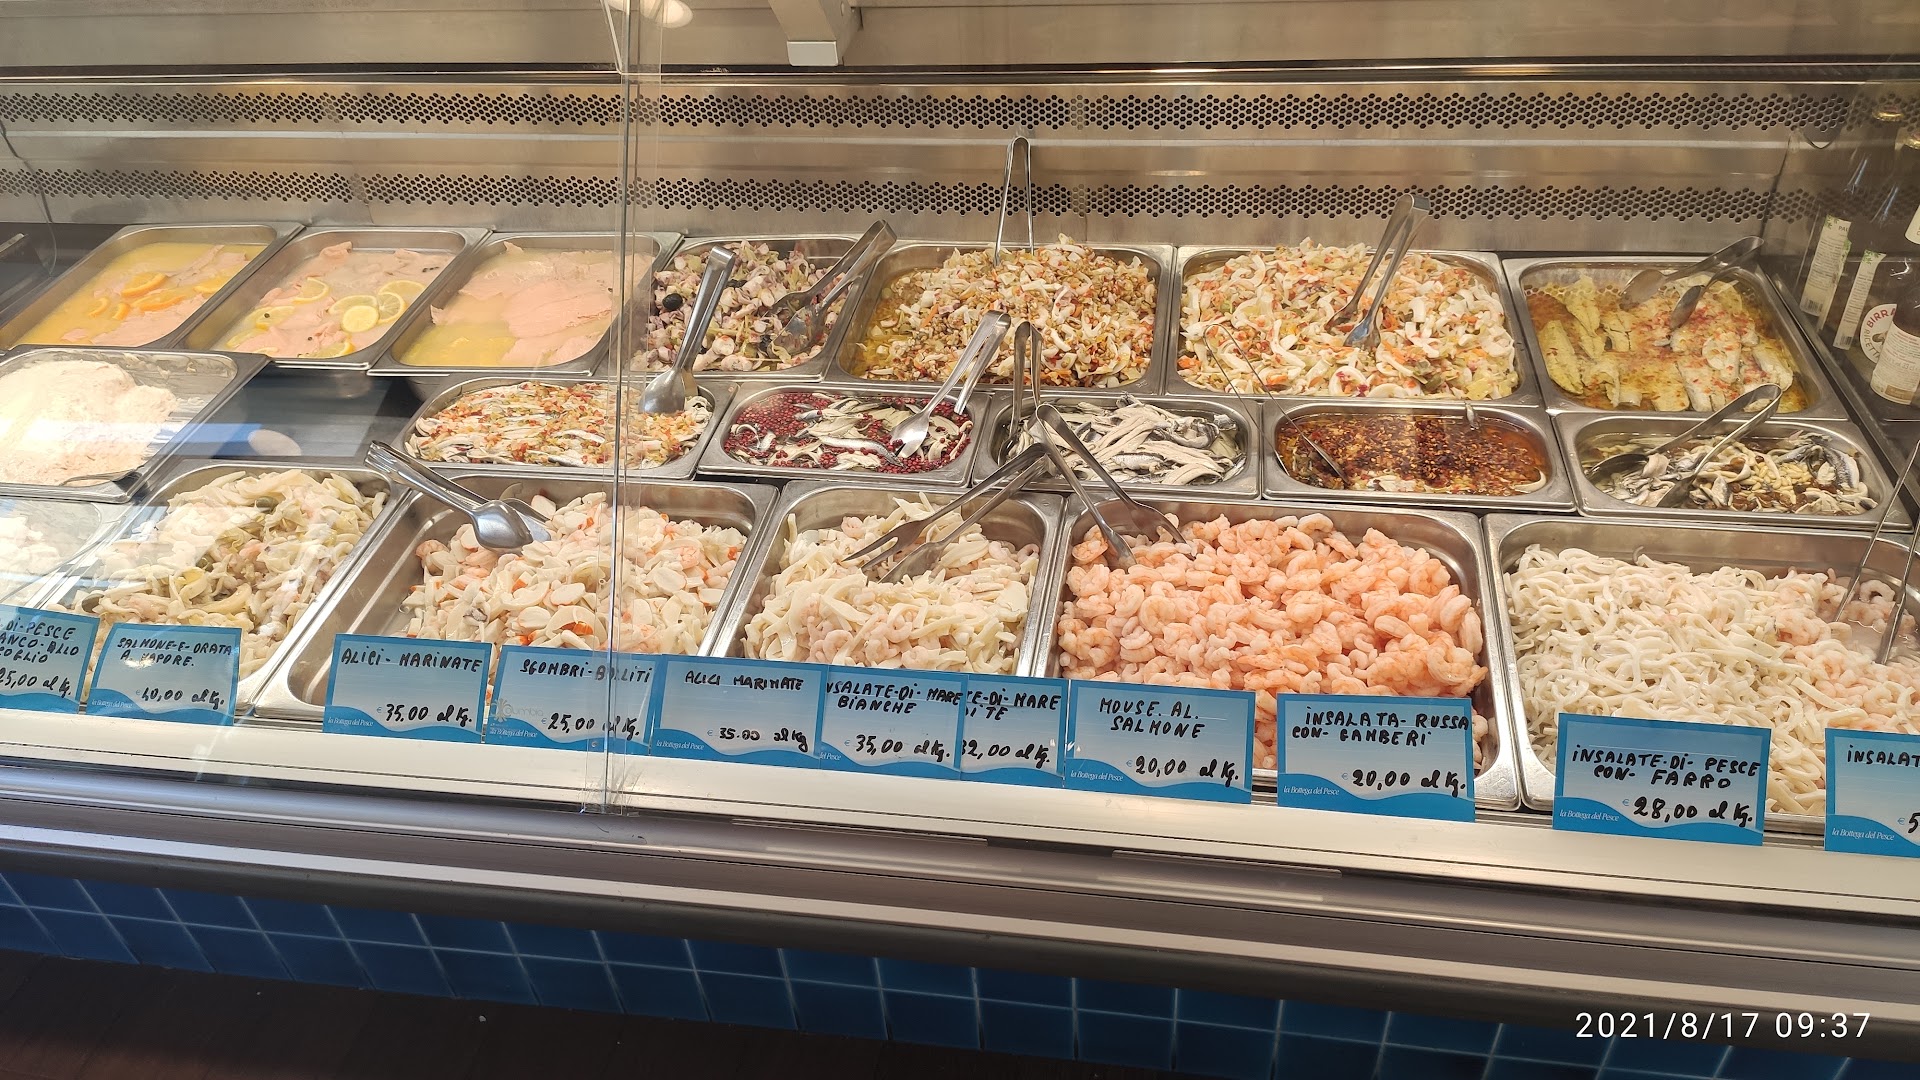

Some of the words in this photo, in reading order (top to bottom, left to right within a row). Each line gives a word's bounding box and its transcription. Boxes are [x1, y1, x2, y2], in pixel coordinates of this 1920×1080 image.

[399, 651, 483, 672] MARINATE
[685, 670, 721, 686] ALICI
[733, 675, 804, 691] MARINATE
[837, 695, 917, 714] BIANCHE
[1014, 692, 1061, 710] MARE
[360, 719, 374, 727] Pesce
[437, 705, 455, 722] al
[548, 712, 595, 733] 25,00
[1415, 713, 1470, 730] RUSSA
[1110, 715, 1205, 738] SALMONE
[690, 742, 704, 750] Pesce
[856, 734, 903, 756] 35,00
[913, 739, 930, 755] al
[1015, 743, 1035, 760] al
[1070, 769, 1077, 778] la
[1078, 770, 1098, 781] Bottega
[1098, 771, 1107, 780] del
[1108, 772, 1124, 782] Pesce
[1135, 755, 1187, 777] 20,00
[1200, 758, 1217, 777] al
[1704, 757, 1761, 777] PESCE
[1352, 769, 1411, 791] 20,00
[1420, 769, 1441, 788] al
[1650, 769, 1732, 789] FARRO
[1283, 785, 1290, 793] la
[1291, 786, 1313, 796] Bottega
[1313, 786, 1323, 795] del
[1323, 787, 1340, 796] Pesce
[1559, 809, 1567, 818] la
[1567, 810, 1592, 821] Bottega
[1592, 811, 1601, 820] del
[1602, 812, 1620, 822] Pesce
[1633, 796, 1698, 823] 28,00
[1708, 800, 1728, 820] al
[1831, 827, 1839, 836] la
[1839, 828, 1864, 839] Bottega
[1865, 830, 1876, 839] del
[1876, 831, 1895, 841] Pesce
